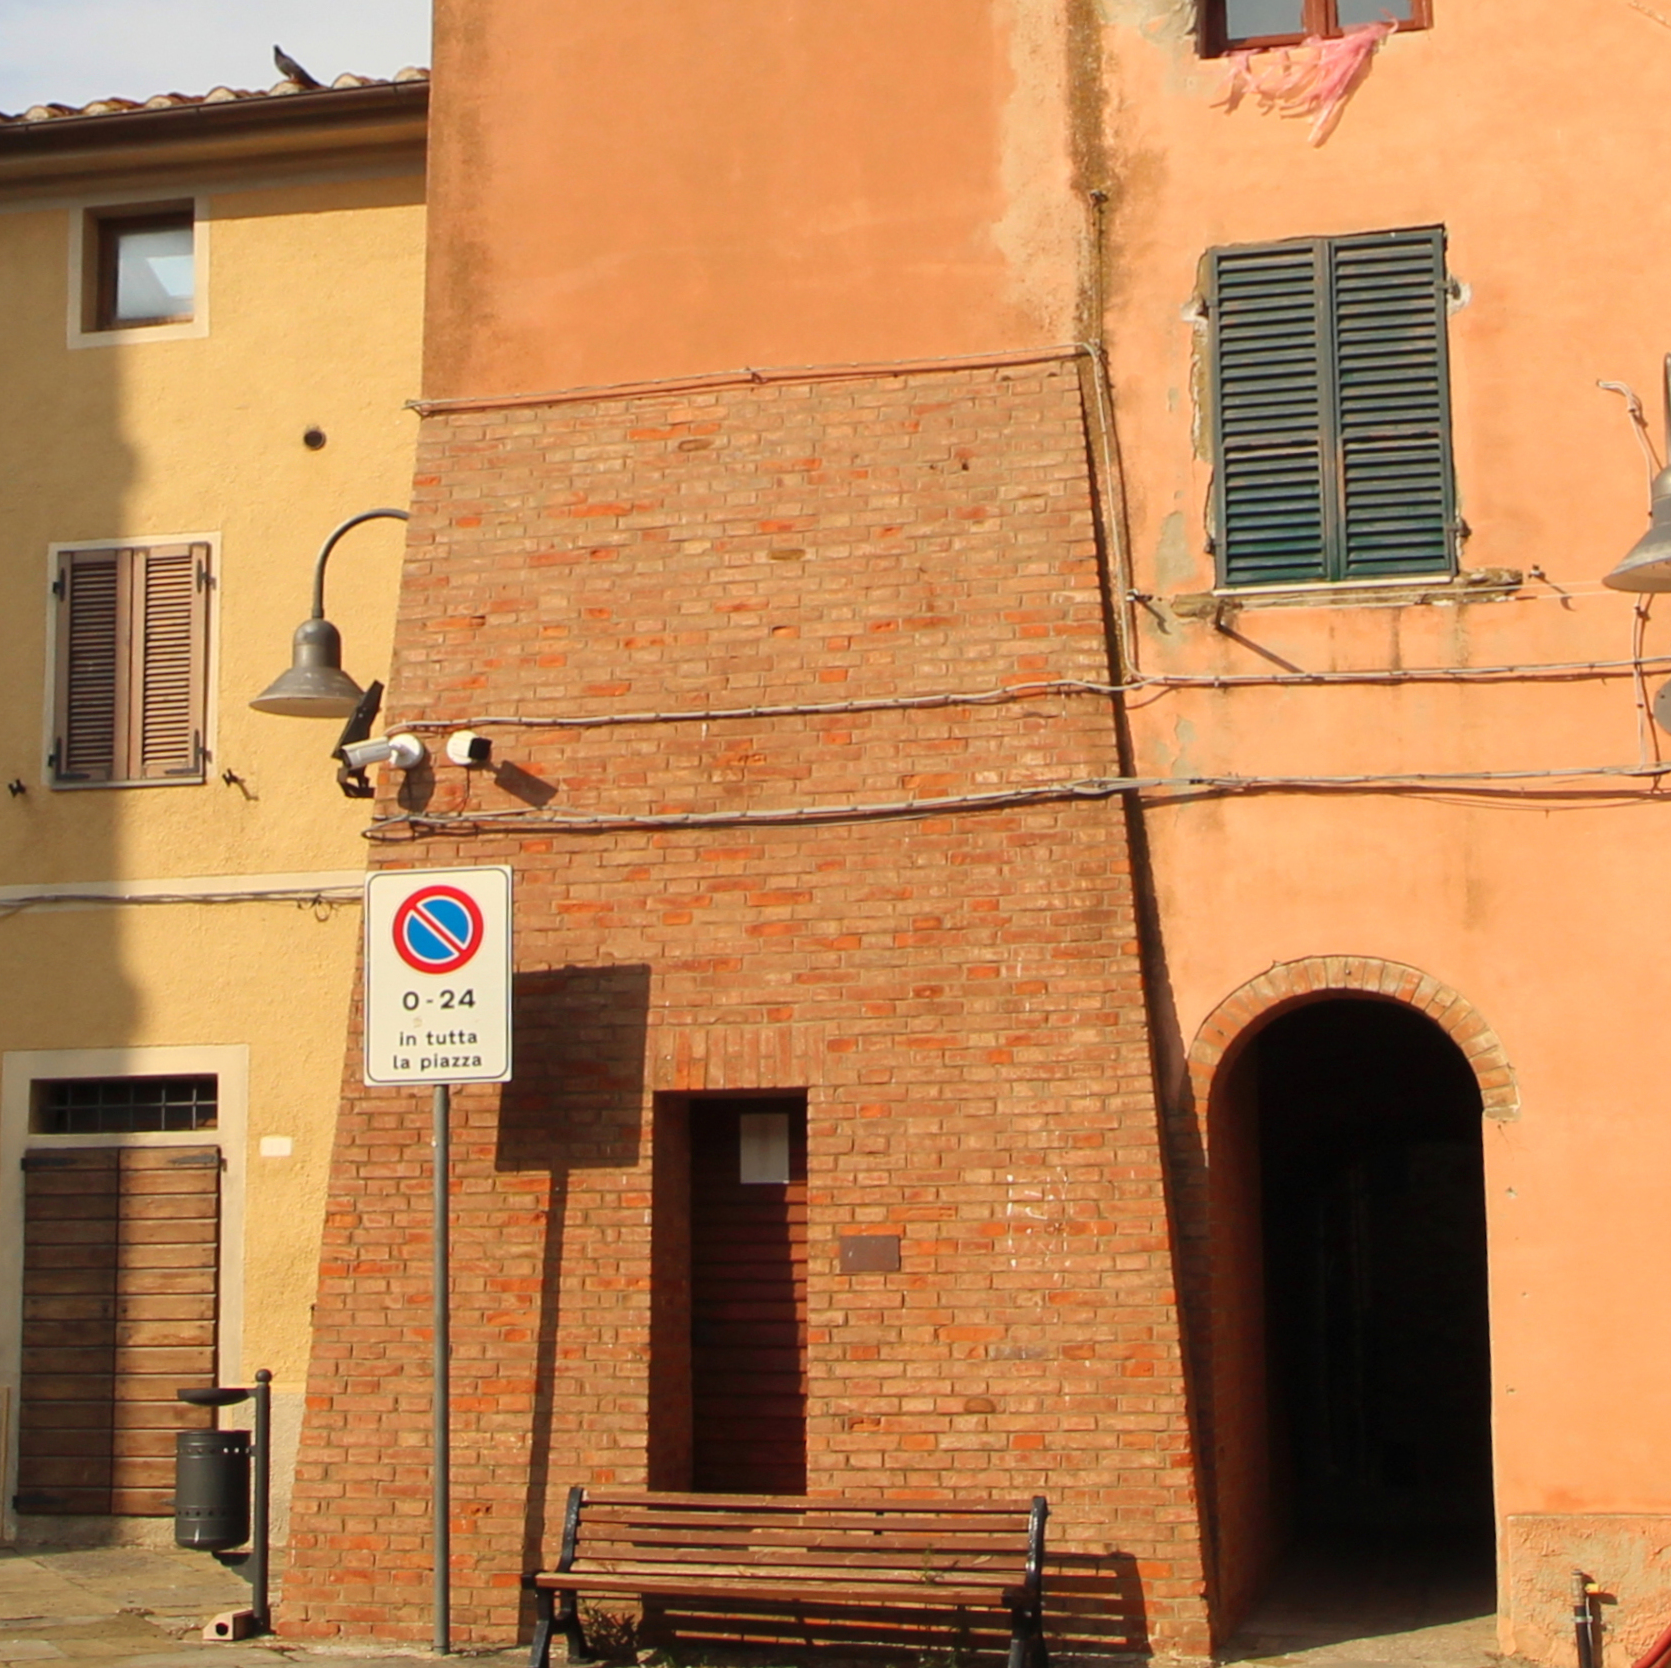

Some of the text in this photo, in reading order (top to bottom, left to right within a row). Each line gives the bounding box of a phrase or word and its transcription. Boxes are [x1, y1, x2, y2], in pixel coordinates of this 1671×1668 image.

[399, 1029, 478, 1047] in tutta
[393, 1052, 482, 1072] la piazza
